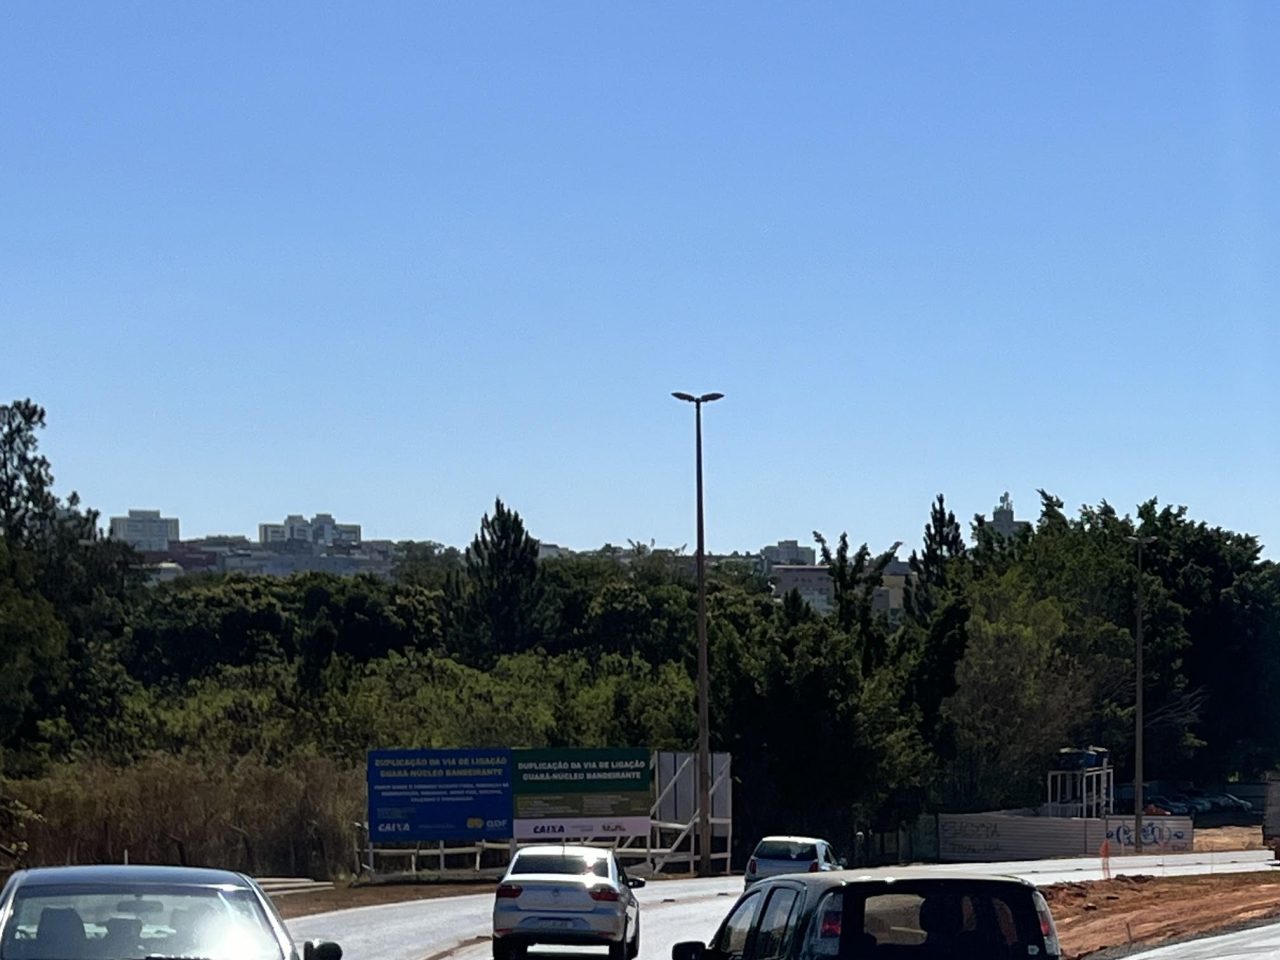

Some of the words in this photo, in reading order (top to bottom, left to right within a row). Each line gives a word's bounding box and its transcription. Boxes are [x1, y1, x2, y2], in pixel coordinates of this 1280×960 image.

[441, 758, 456, 766] VIA
[518, 760, 570, 771] DUPLICAÇÃO
[598, 761, 609, 769] DE
[610, 760, 646, 770] LIGAÇÃO
[586, 770, 642, 779] BANDEIRANTE
[378, 822, 410, 832] CAIXA
[533, 824, 565, 834] CAIXA
